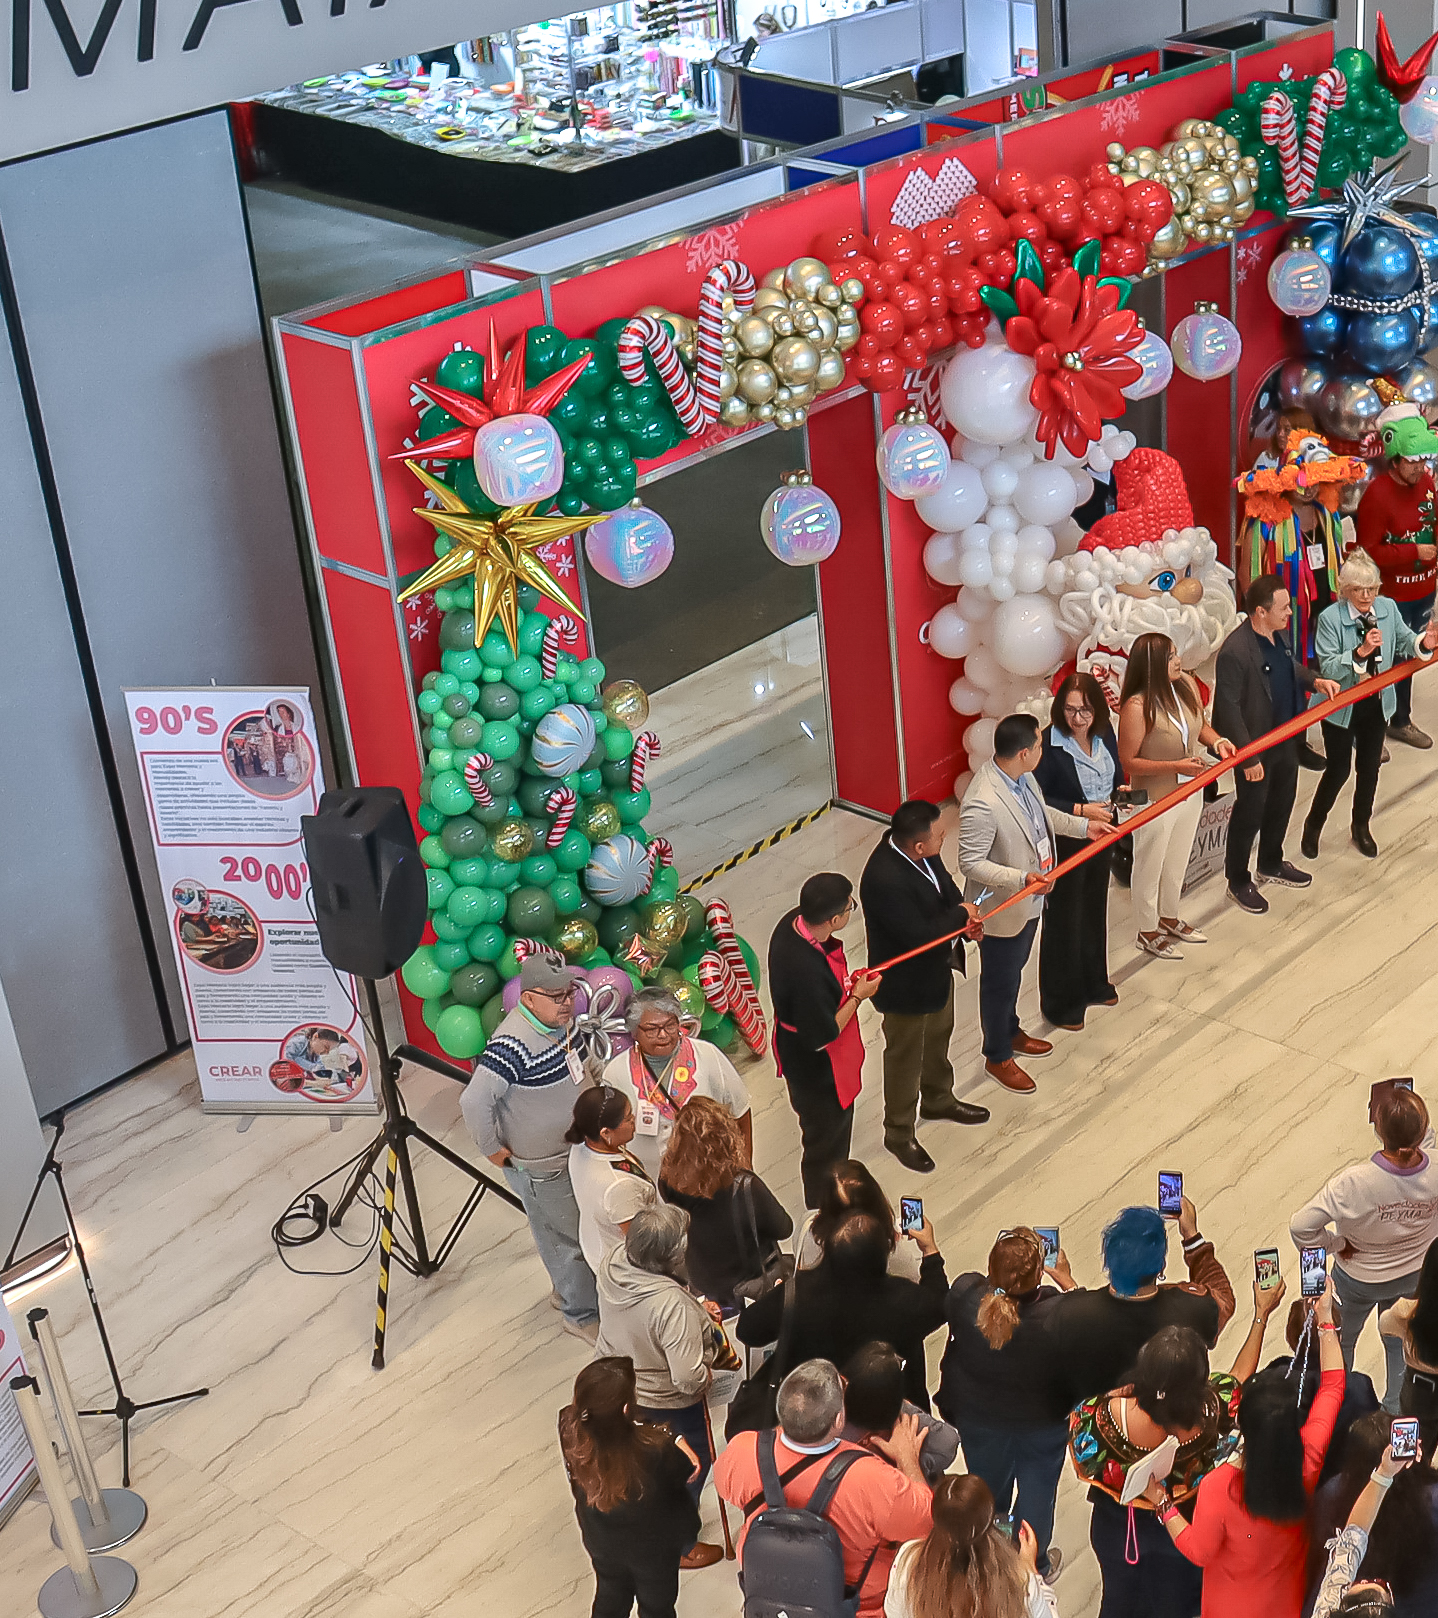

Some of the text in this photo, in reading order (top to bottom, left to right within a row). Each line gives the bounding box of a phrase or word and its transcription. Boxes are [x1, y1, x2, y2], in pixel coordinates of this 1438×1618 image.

[135, 705, 219, 735] 90'S
[219, 856, 307, 900] 2000'
[269, 938, 320, 946] oportunidad
[209, 1065, 263, 1077] CREAR
